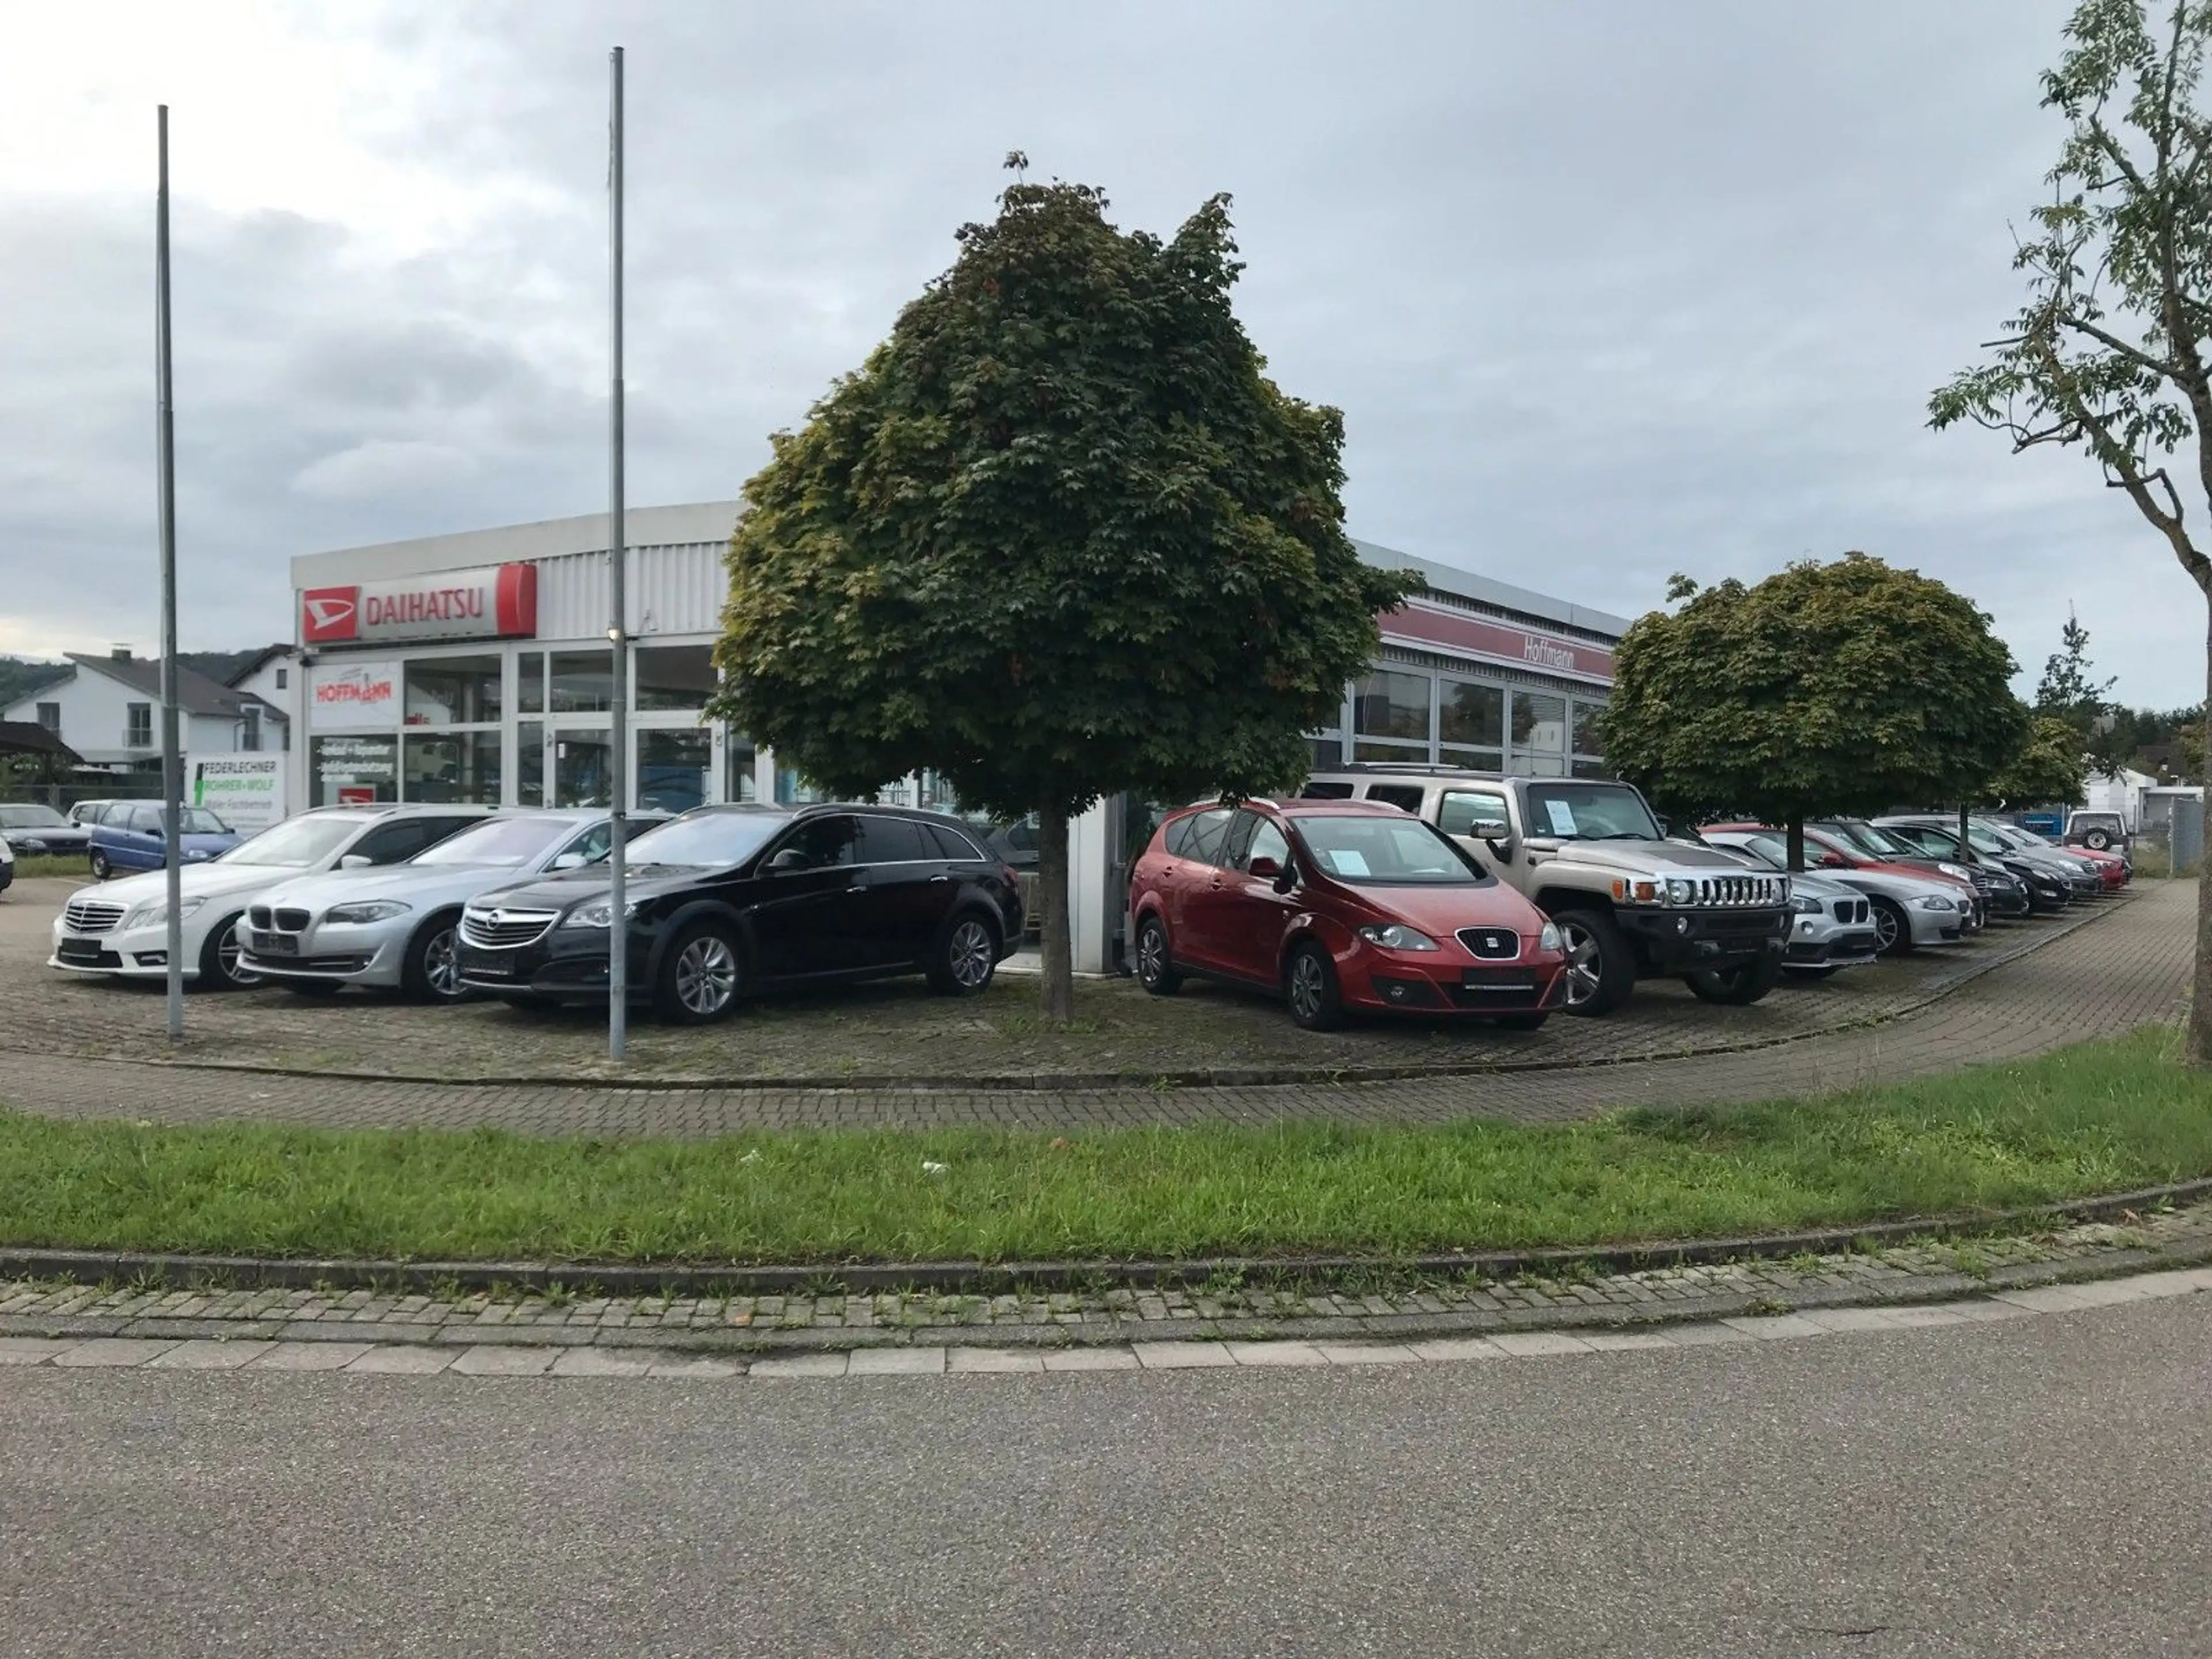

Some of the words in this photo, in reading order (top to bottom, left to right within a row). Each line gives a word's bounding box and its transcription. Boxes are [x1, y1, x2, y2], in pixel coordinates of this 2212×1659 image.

[366, 586, 484, 626] DAIHATSU
[1524, 635, 1574, 669] Hoffmann
[317, 681, 391, 703] HOFFMANN
[203, 761, 276, 774] FEDERLECHNER
